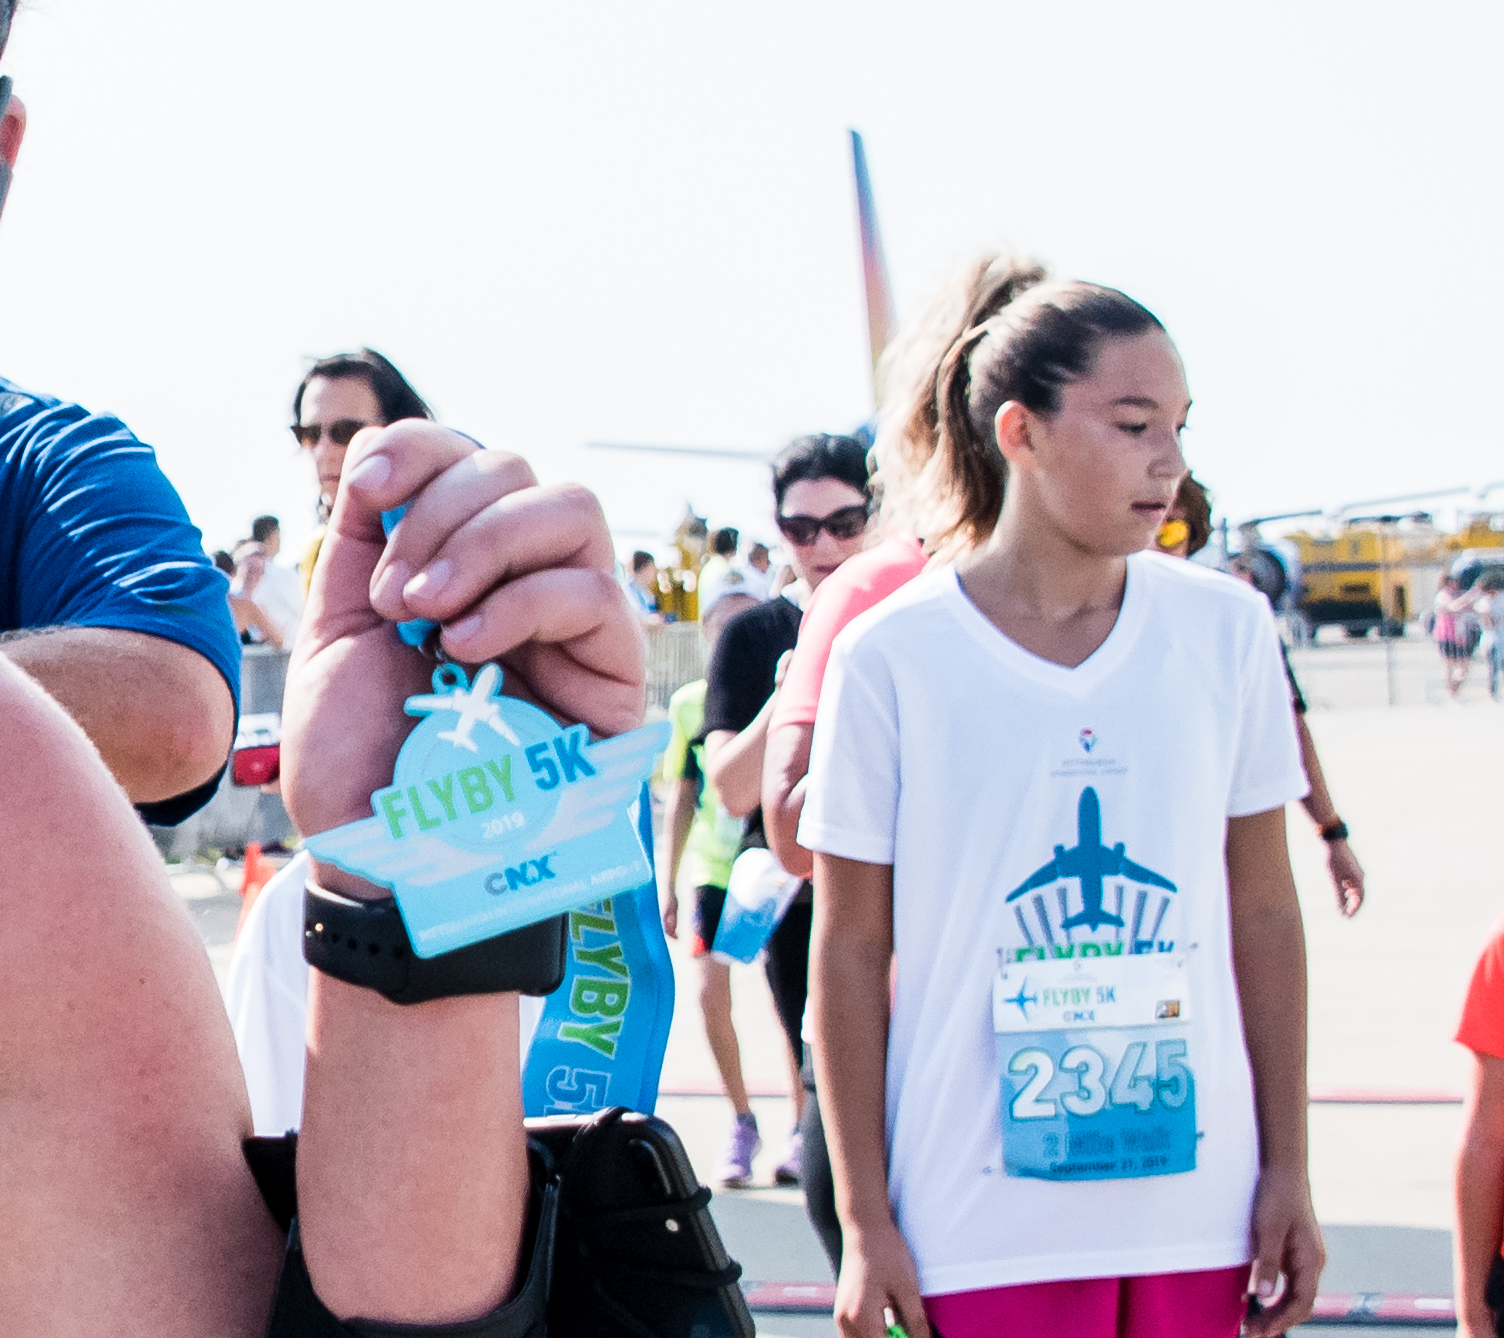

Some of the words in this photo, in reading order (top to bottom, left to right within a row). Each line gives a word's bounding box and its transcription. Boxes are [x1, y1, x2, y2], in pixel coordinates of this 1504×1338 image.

[378, 755, 517, 841] FLYBY
[524, 729, 596, 792] 5K
[479, 810, 525, 839] 2019
[483, 854, 556, 896] CNX
[1007, 1038, 1190, 1120] 2345
